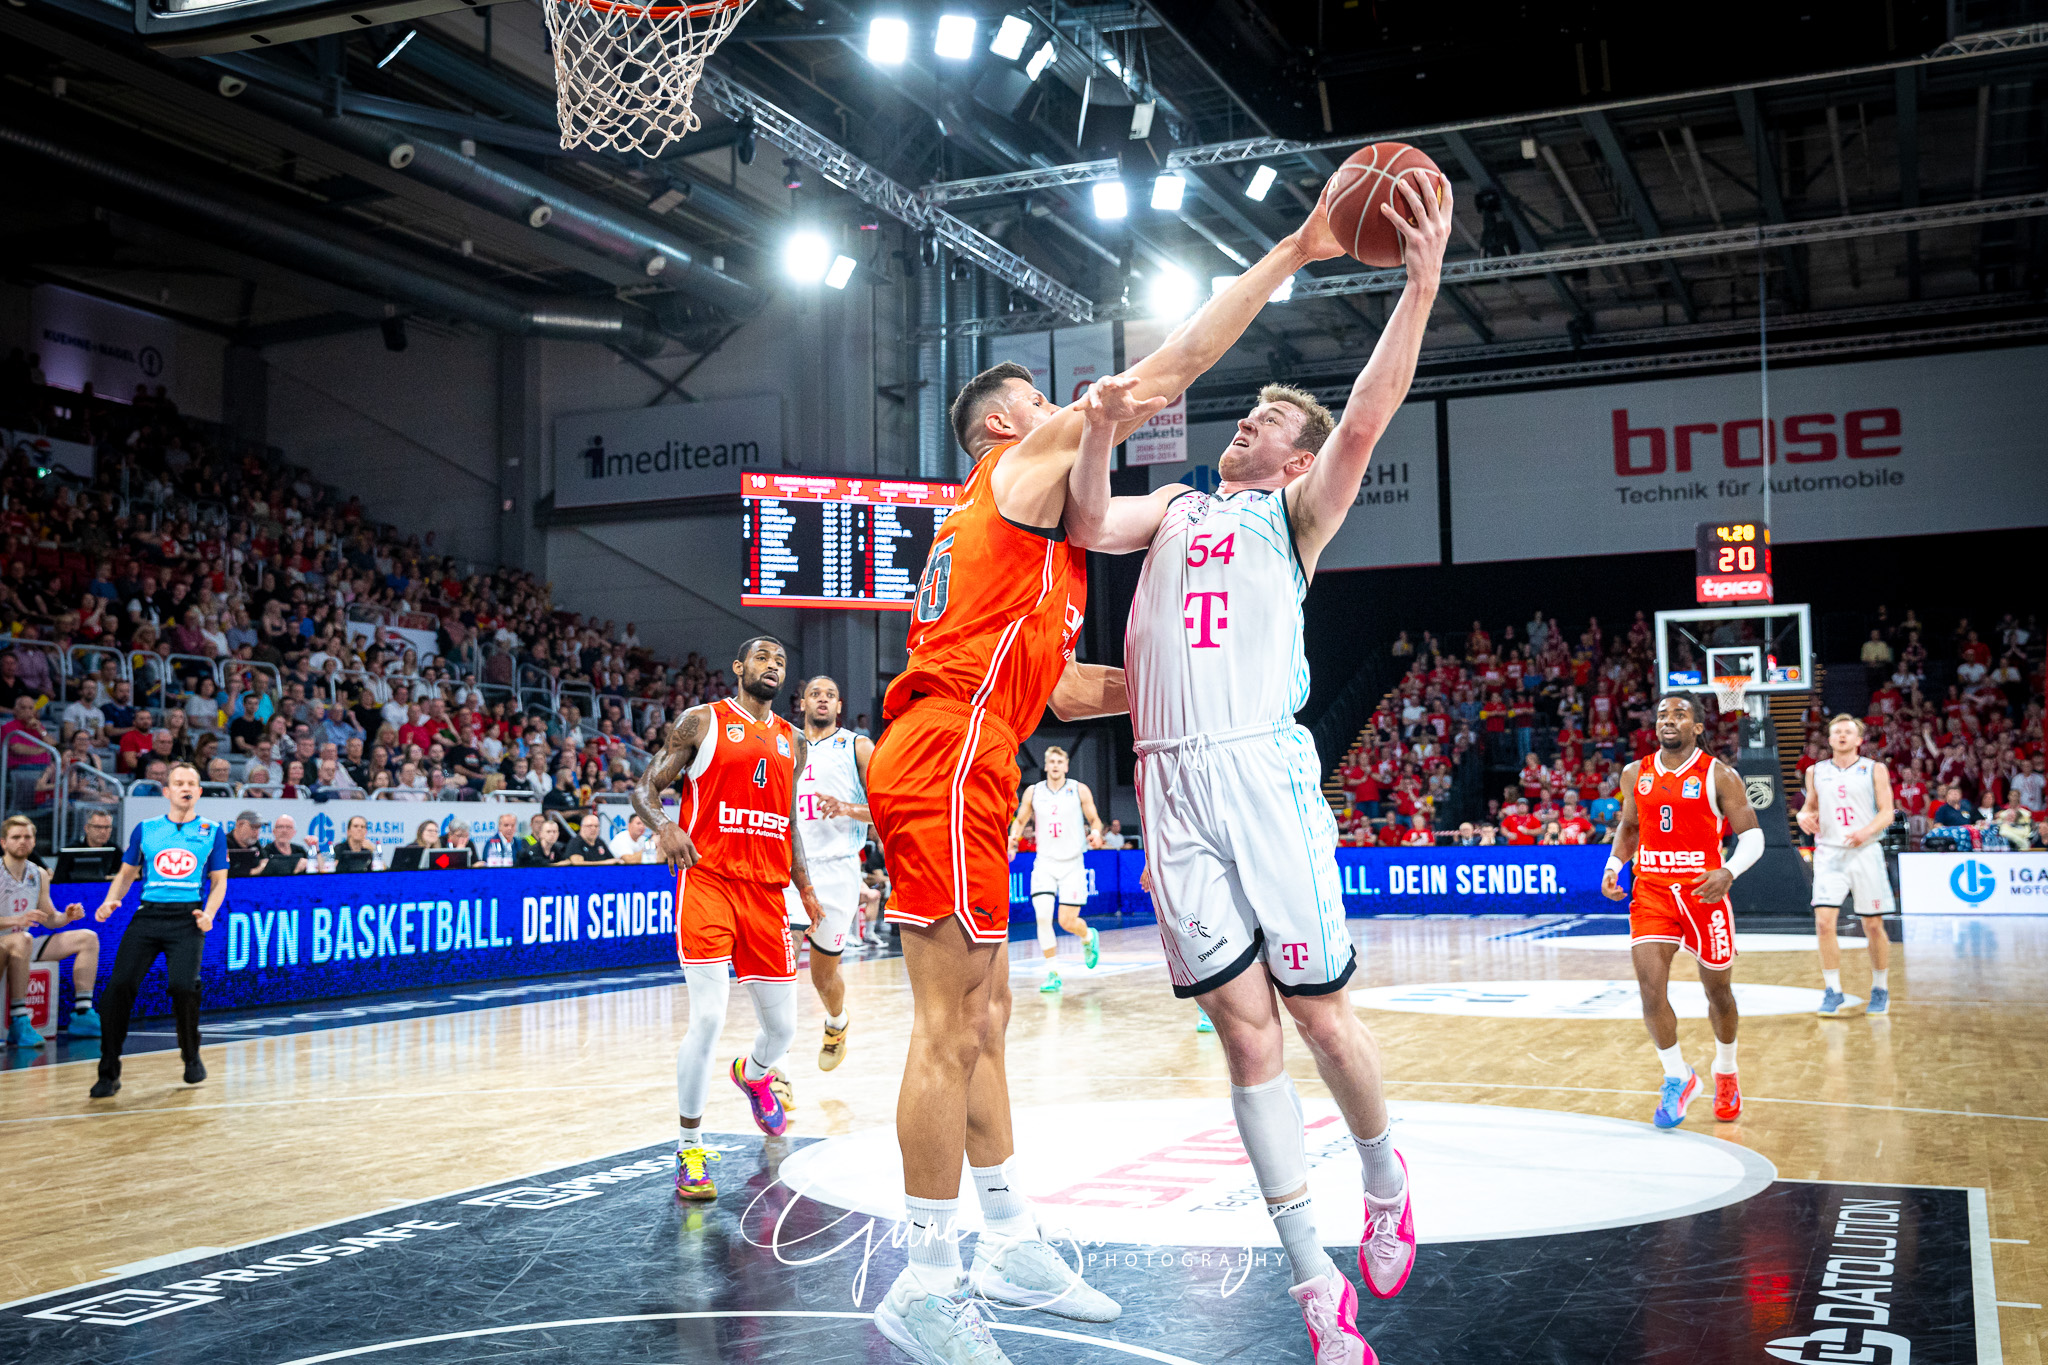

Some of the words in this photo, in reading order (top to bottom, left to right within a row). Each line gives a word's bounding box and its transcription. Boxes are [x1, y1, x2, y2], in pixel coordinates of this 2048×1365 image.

[1612, 408, 1903, 477] brose
[606, 440, 760, 477] mediteam
[750, 475, 768, 489] 10
[940, 485, 955, 498] 11
[1615, 482, 1709, 505] Technik
[1717, 479, 1751, 498] für
[1757, 469, 1906, 495] Automobile
[1187, 532, 1236, 568] 54
[1718, 546, 1756, 573] 20
[1701, 578, 1764, 599] tipico
[753, 758, 768, 788] 4
[803, 763, 816, 781] 1
[1838, 784, 1847, 799] 5
[718, 801, 790, 833] brose
[1051, 804, 1058, 816] 2
[1659, 804, 1674, 833] 3
[718, 825, 745, 834] Technik
[1639, 844, 1706, 867] brose
[1389, 864, 1448, 895] DEIN
[1455, 863, 1567, 895] SENDER.
[14, 898, 28, 913] 19
[227, 909, 300, 972] DYN
[312, 898, 513, 964] BASKETBALL.
[522, 894, 580, 945] DEIN
[586, 890, 678, 940] SENDER.
[1197, 936, 1229, 963] SPALDING
[163, 1218, 461, 1293] PRIOSAFE
[1813, 1198, 1902, 1326] DATOLUTION
